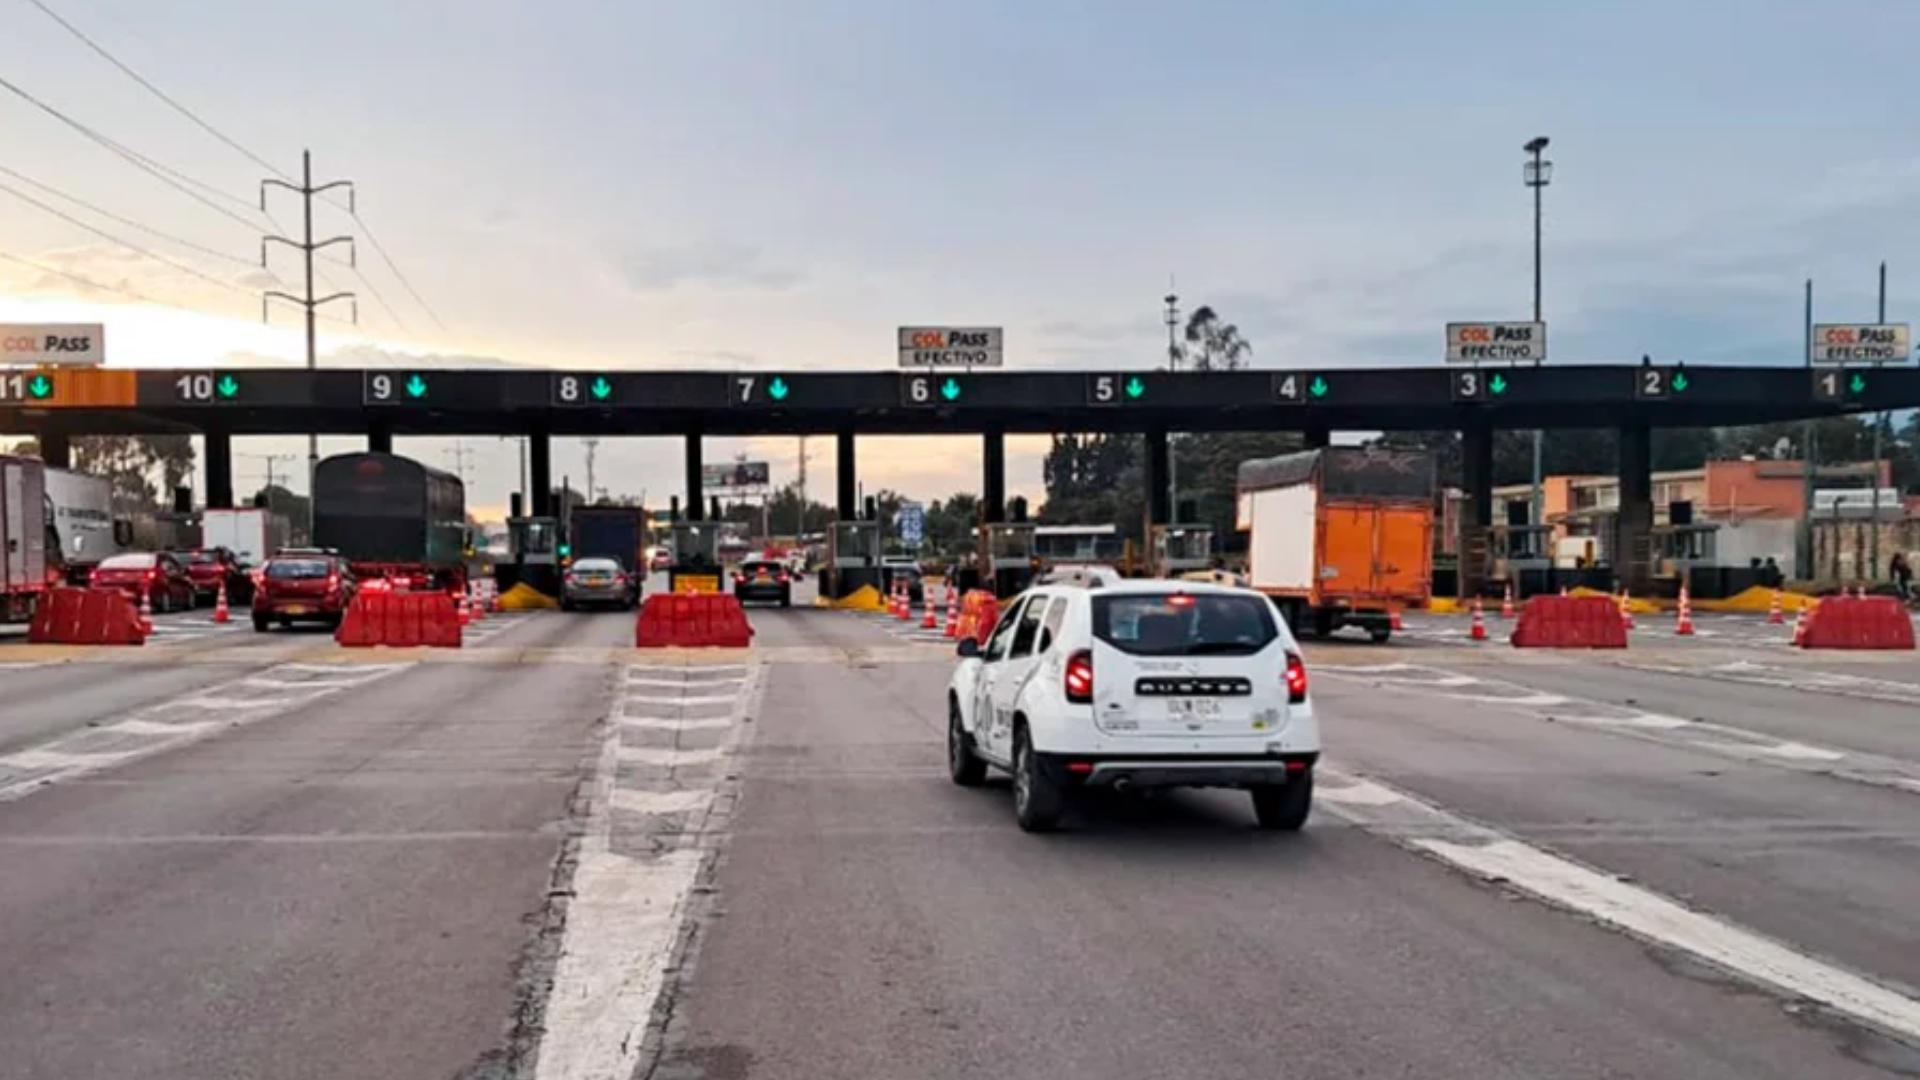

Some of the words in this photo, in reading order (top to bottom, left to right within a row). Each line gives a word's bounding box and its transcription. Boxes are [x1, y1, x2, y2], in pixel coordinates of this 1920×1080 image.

[5, 336, 38, 352] COL
[45, 335, 91, 352] PASS
[912, 330, 945, 347] COL
[949, 330, 989, 347] PASS
[1459, 327, 1490, 342] COL
[1493, 326, 1532, 342] PASS
[1826, 328, 1855, 343] COL
[1858, 327, 1896, 343] PASS
[914, 350, 988, 365] EFECTIVO
[1460, 344, 1531, 358] EFECTIVO
[176, 375, 211, 399] 10
[372, 375, 391, 399] 9
[560, 377, 578, 401] 8
[738, 378, 754, 401] 7
[911, 379, 928, 402] 6
[1096, 377, 1113, 401] 5
[1280, 376, 1297, 399] 4
[1460, 373, 1477, 396] 3
[1645, 371, 1661, 394] 2
[1821, 373, 1836, 396] 1
